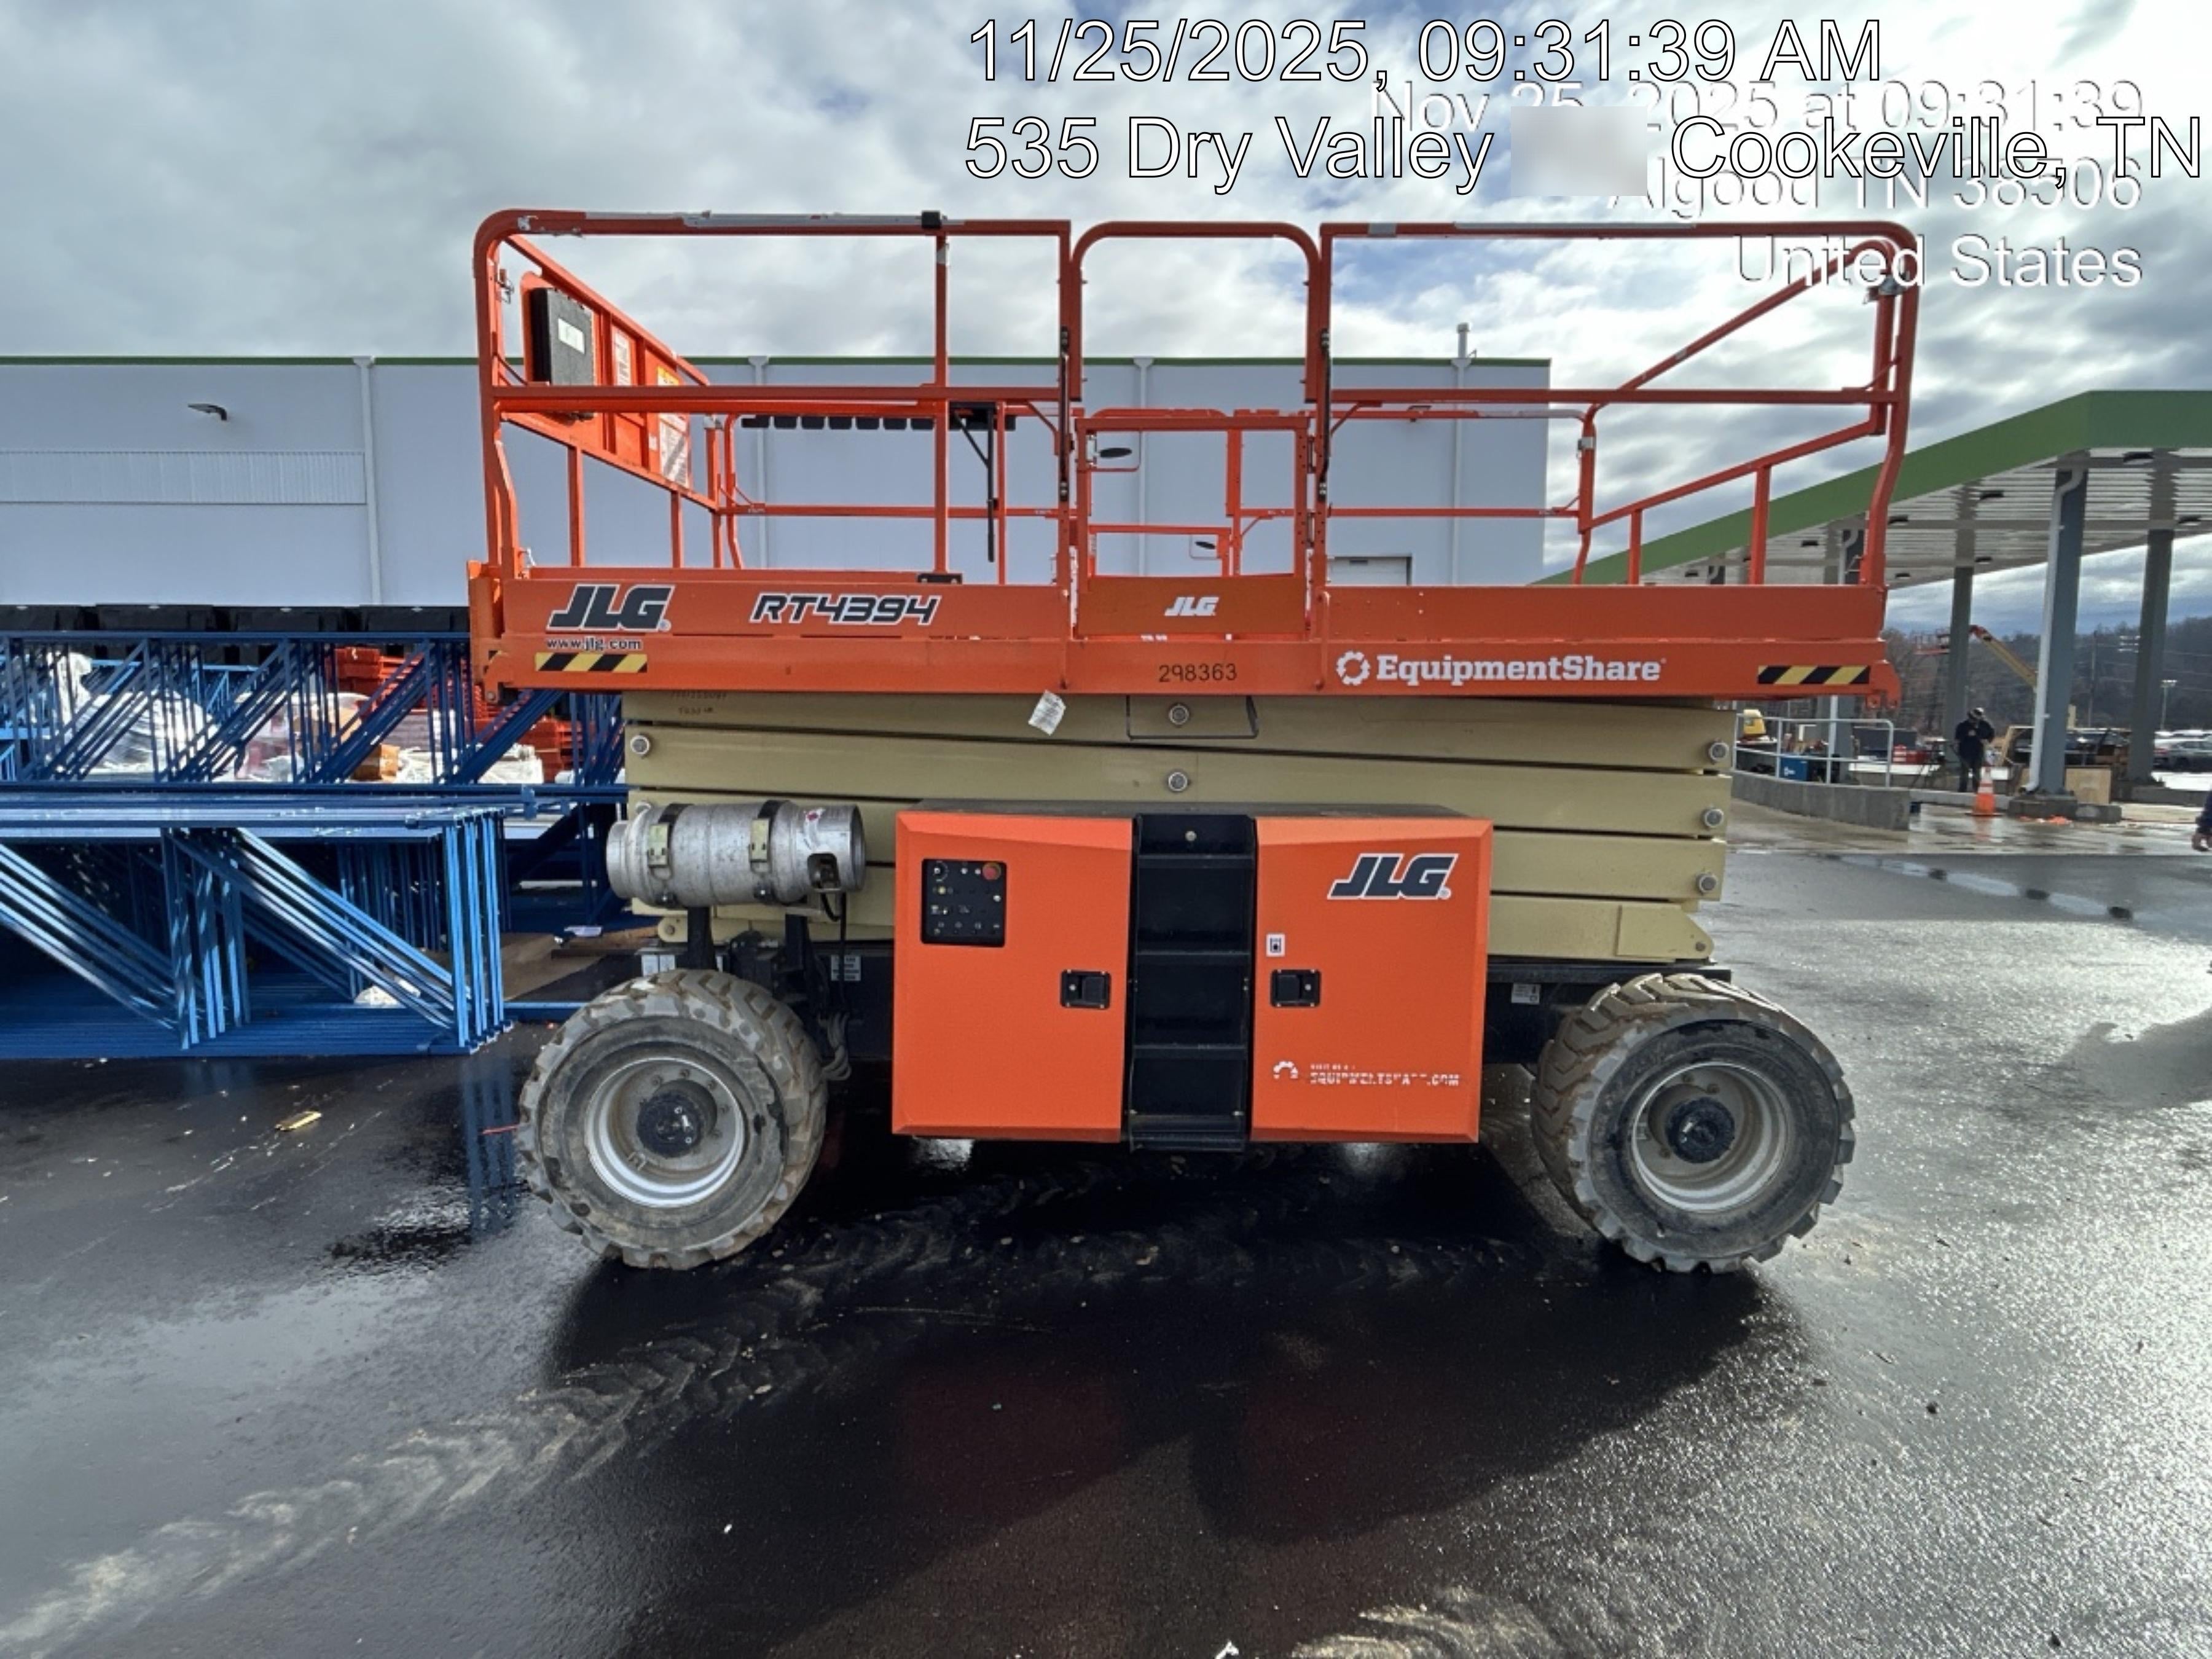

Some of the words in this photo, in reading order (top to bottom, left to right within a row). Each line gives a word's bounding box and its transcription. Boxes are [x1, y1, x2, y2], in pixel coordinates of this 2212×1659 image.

[749, 592, 942, 626] RT4394
[1164, 596, 1220, 616] JLG
[546, 635, 643, 651] www.jlg.com
[1158, 662, 1237, 683] 298363
[1376, 654, 1661, 687] EquipmentShare
